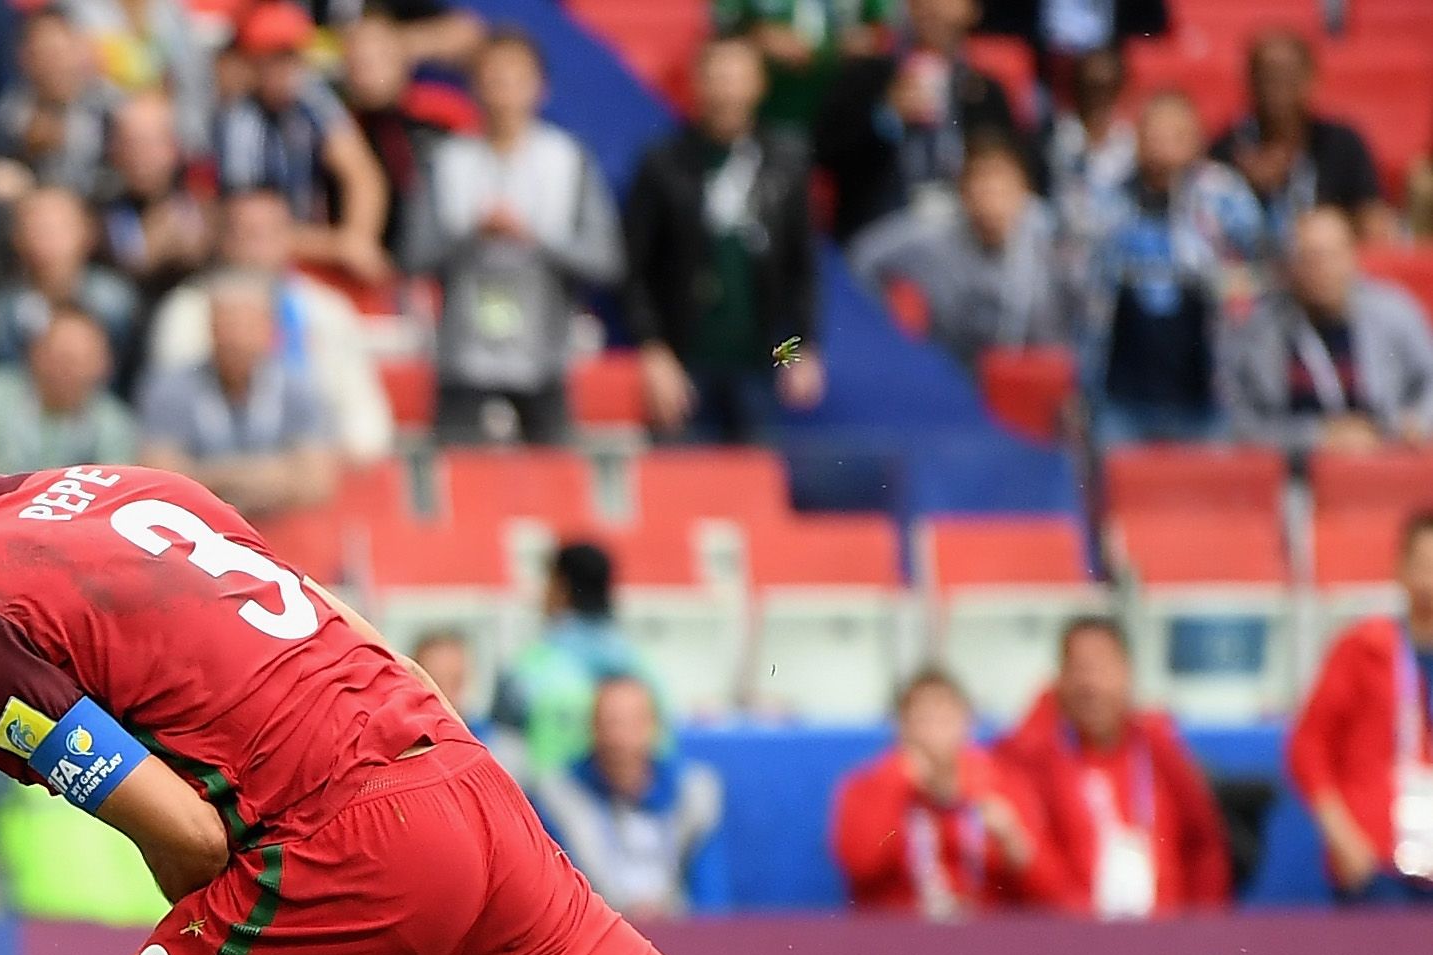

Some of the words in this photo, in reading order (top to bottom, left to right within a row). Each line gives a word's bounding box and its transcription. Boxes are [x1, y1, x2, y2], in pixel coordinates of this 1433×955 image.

[18, 465, 121, 521] PEPE
[109, 498, 318, 640] 3
[48, 758, 83, 794] IFA
[80, 756, 108, 785] GAME
[82, 777, 103, 797] FAIR
[99, 752, 124, 778] PLAY
